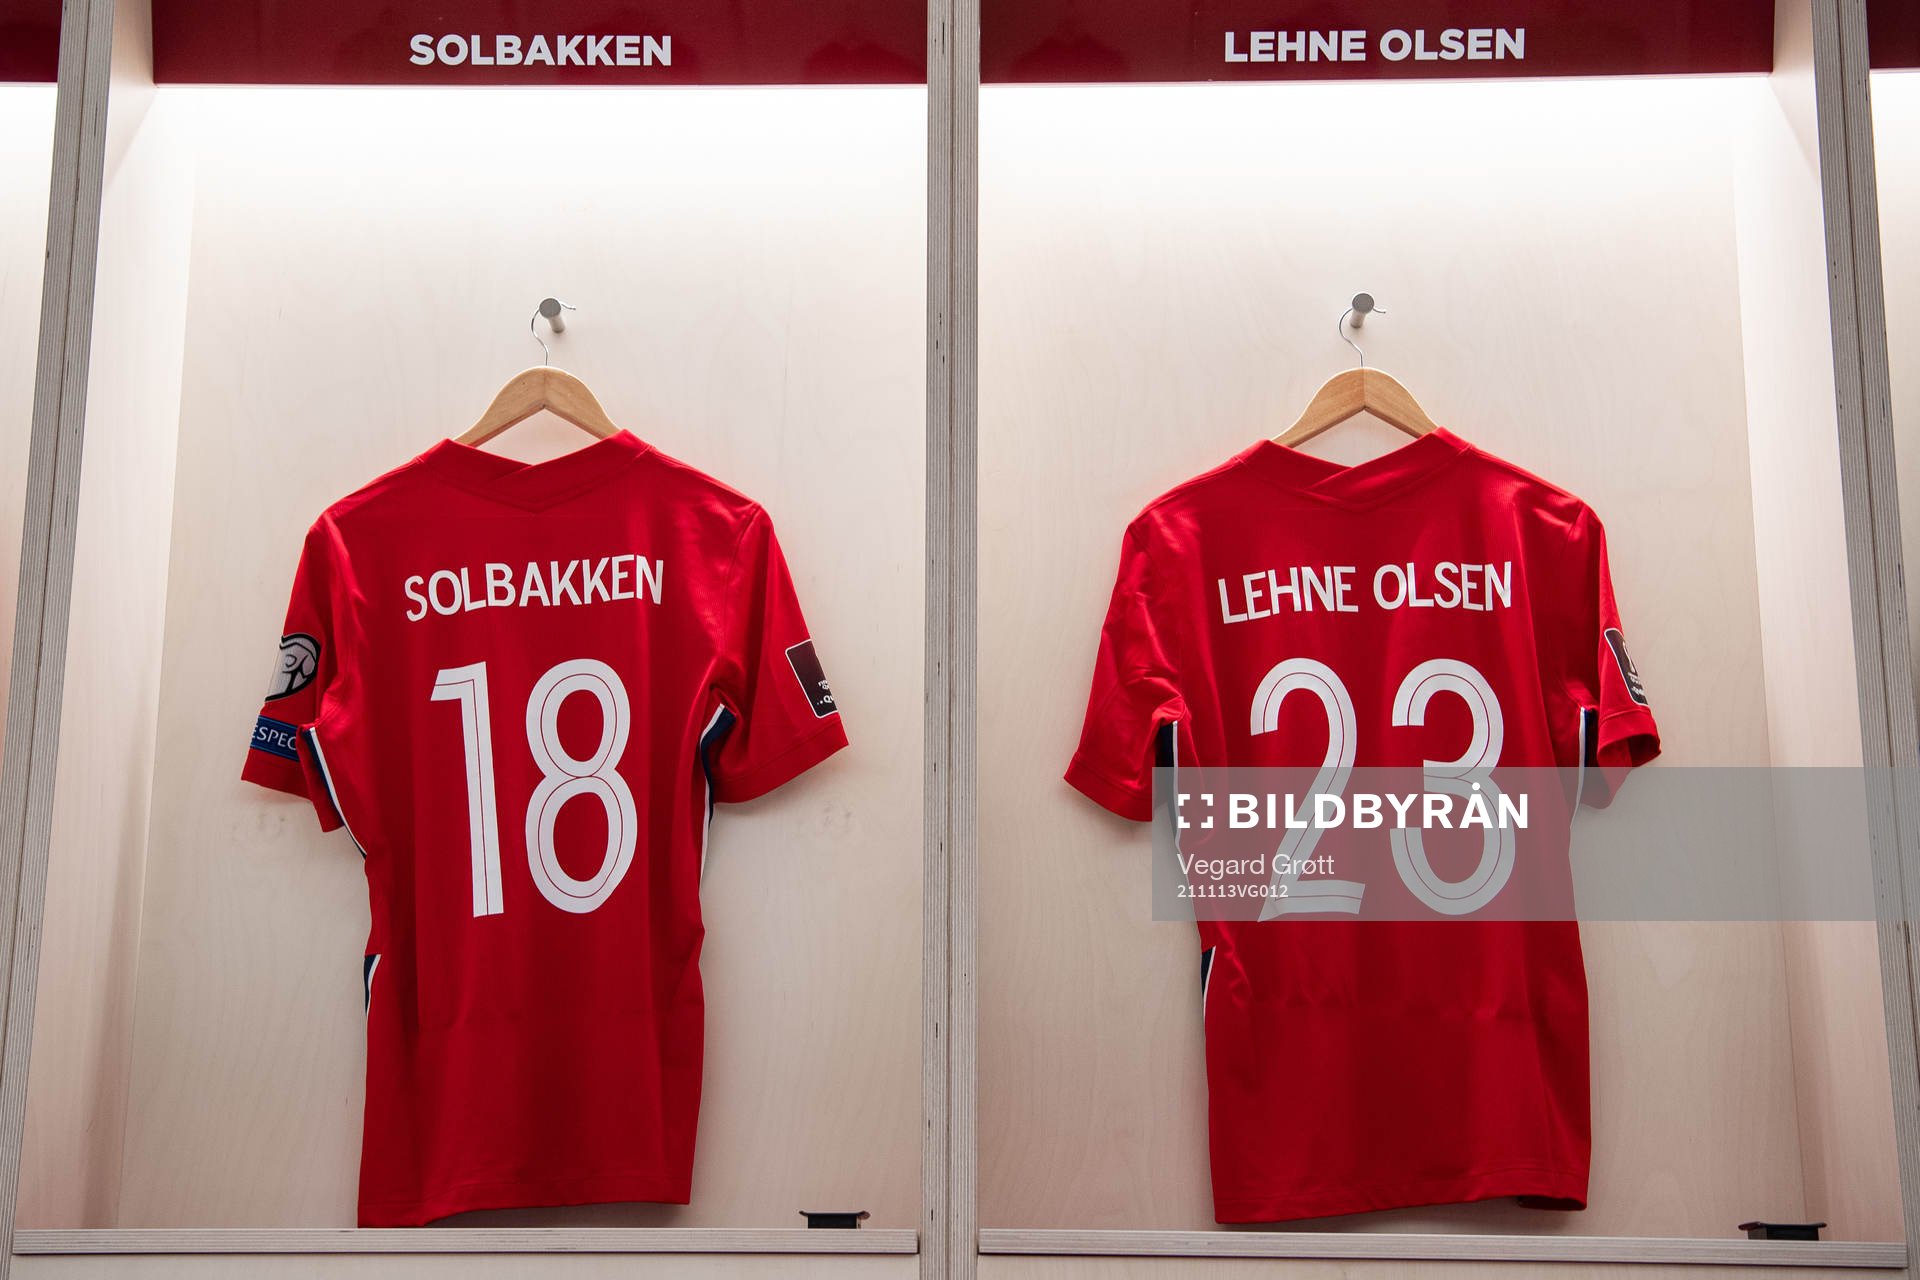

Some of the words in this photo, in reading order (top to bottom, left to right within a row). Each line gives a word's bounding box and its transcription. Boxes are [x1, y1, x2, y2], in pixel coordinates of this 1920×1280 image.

[410, 34, 672, 66] SOLBAKKEN
[1225, 31, 1366, 62] LEHNE
[1380, 29, 1524, 60] OLSEN
[405, 555, 664, 622] SOLBAKKEN
[1218, 566, 1359, 624] LEHNE
[1374, 560, 1512, 611] OLSEN
[431, 658, 638, 917] 18
[1250, 657, 1515, 921] 23
